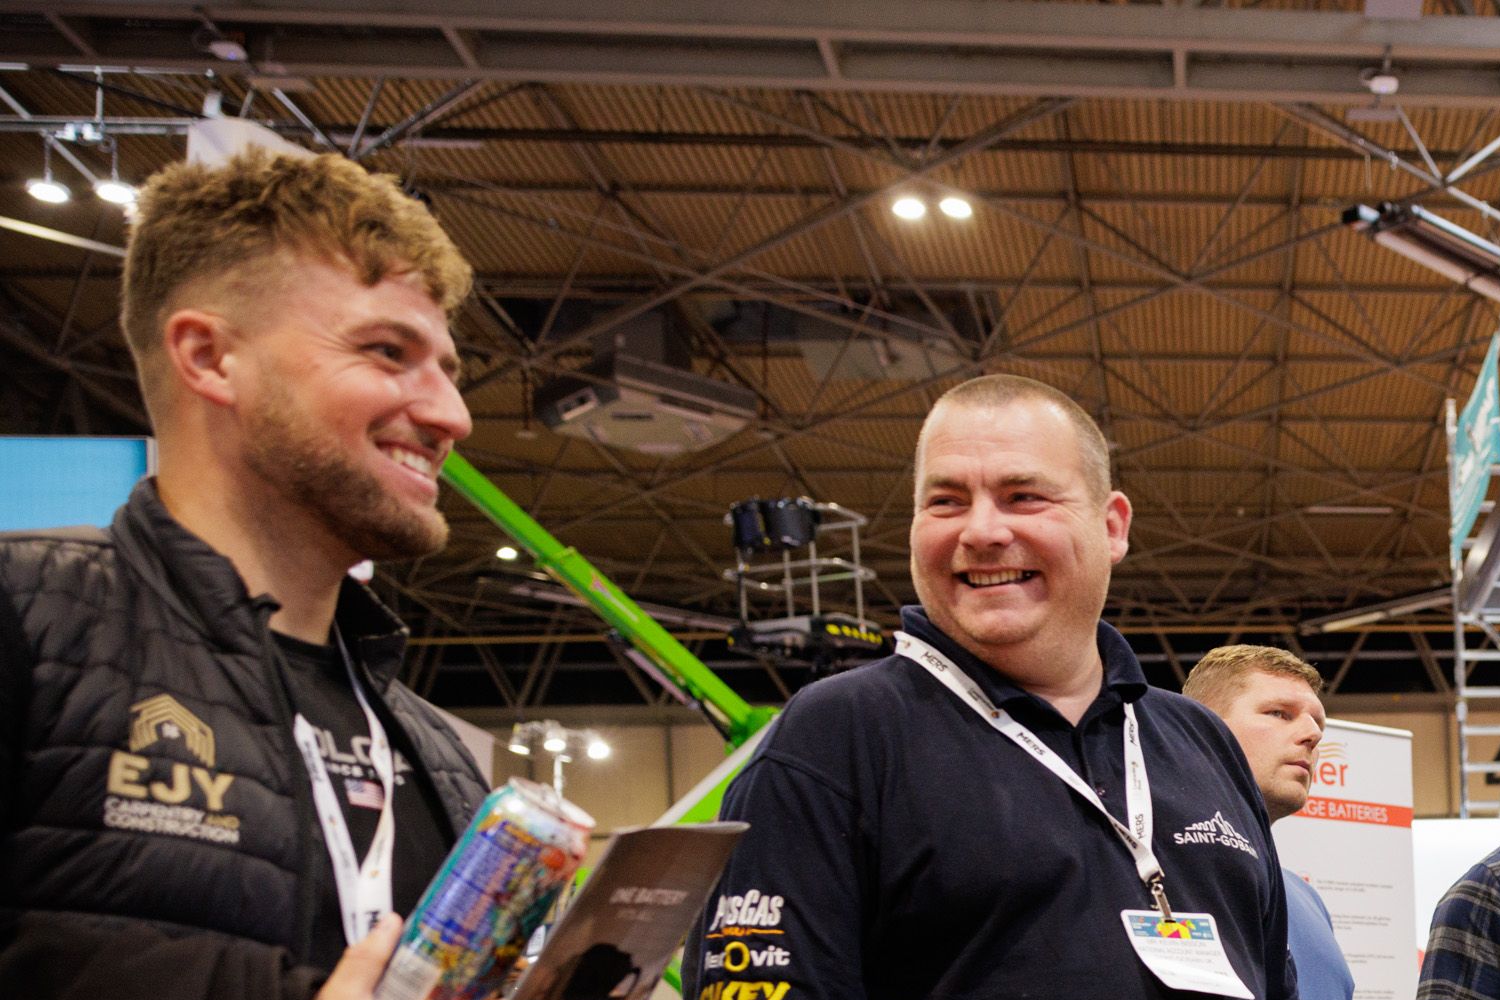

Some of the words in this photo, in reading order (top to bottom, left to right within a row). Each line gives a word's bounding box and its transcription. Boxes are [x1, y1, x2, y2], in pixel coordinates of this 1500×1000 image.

[920, 651, 949, 673] MERS
[106, 750, 236, 812] EJY
[1327, 801, 1389, 823] BATTERIES
